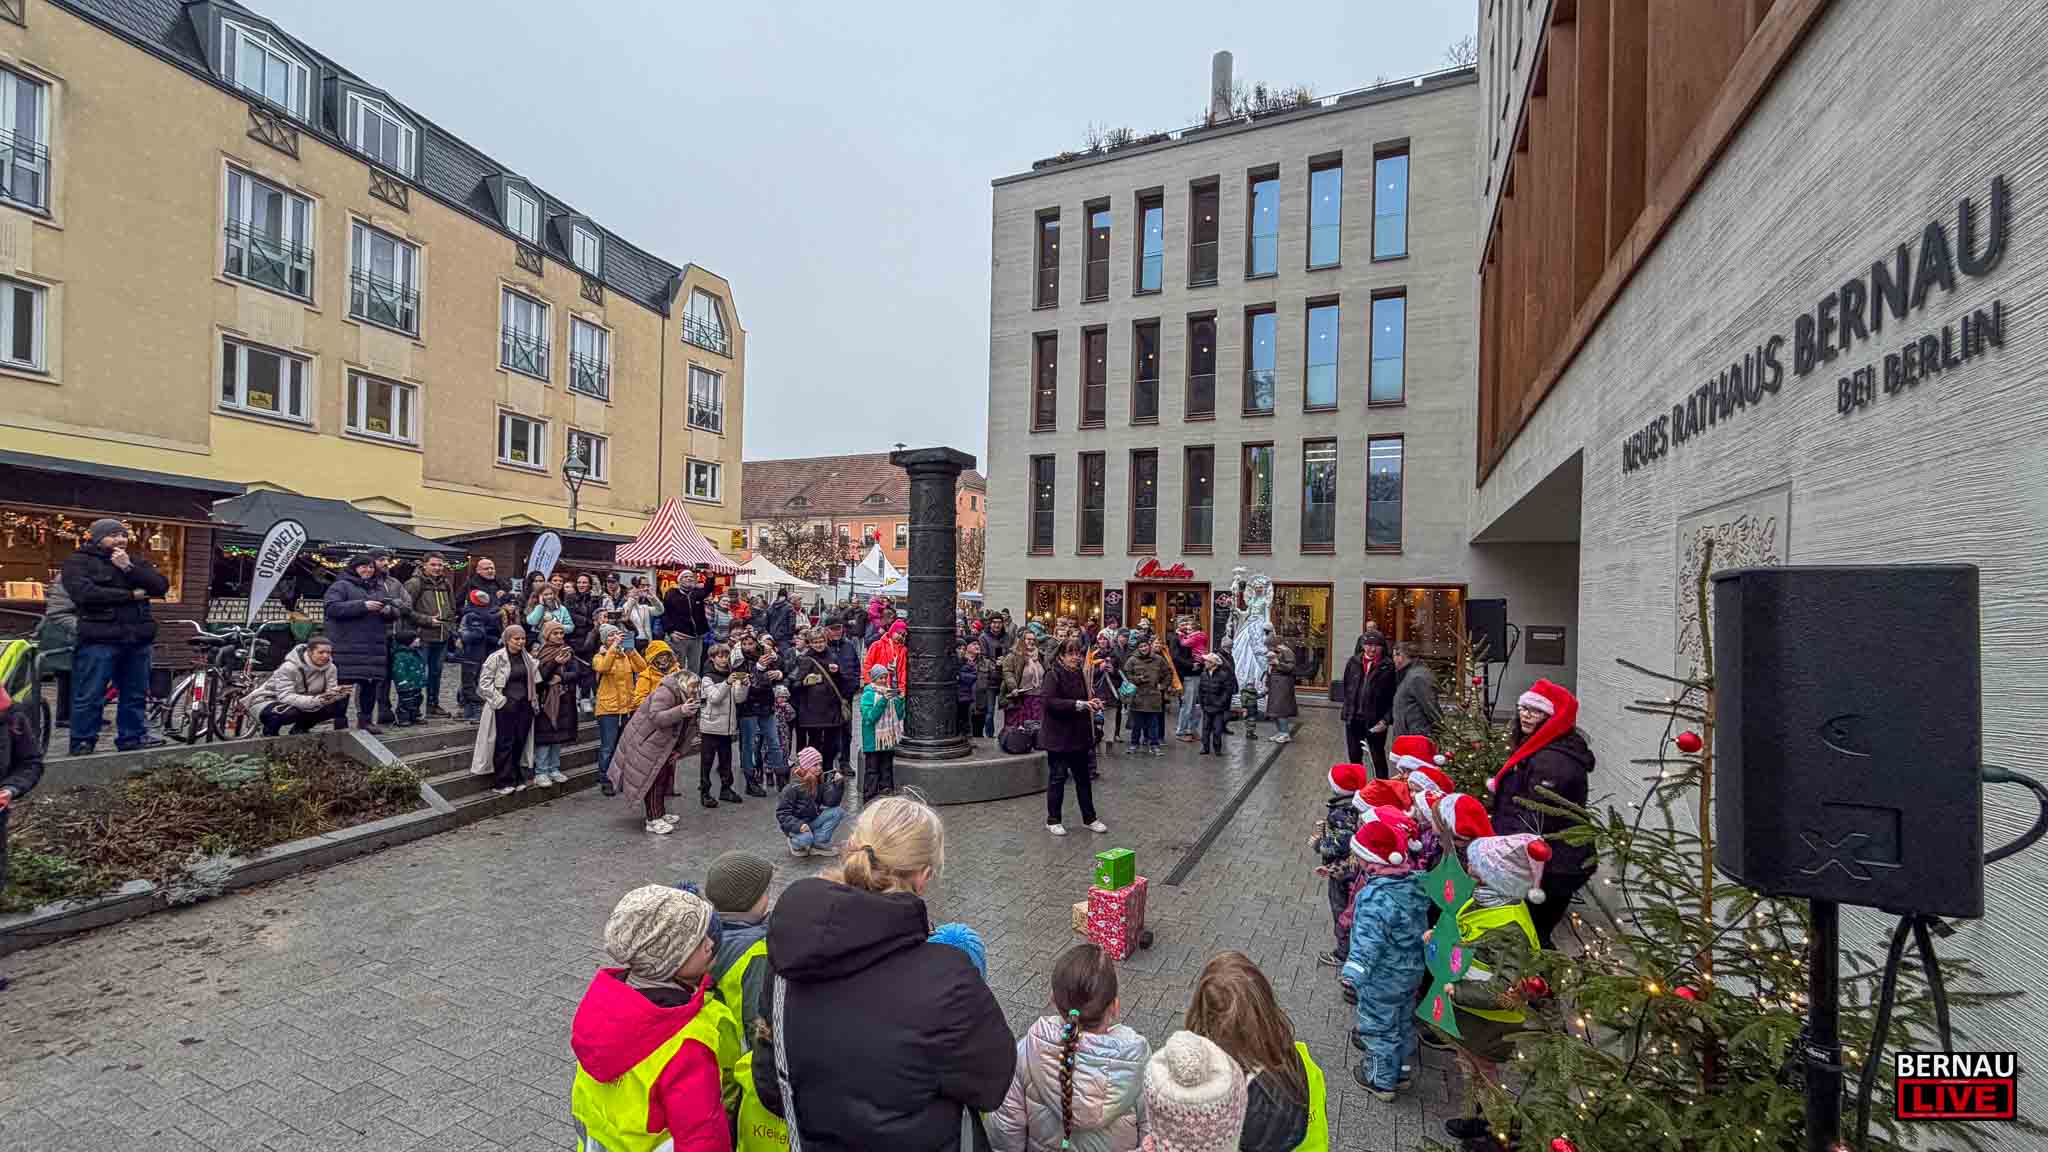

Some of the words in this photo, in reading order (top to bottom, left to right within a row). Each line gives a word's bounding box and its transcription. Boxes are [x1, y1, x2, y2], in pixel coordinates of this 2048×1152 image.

[1622, 414, 1669, 474] NEUES
[1671, 335, 1784, 448] RATHAUS
[1793, 174, 2010, 377] BERNAU
[1838, 364, 1877, 415] BEI
[1883, 300, 2006, 395] BERLIN
[256, 523, 302, 579] O'DONNELL
